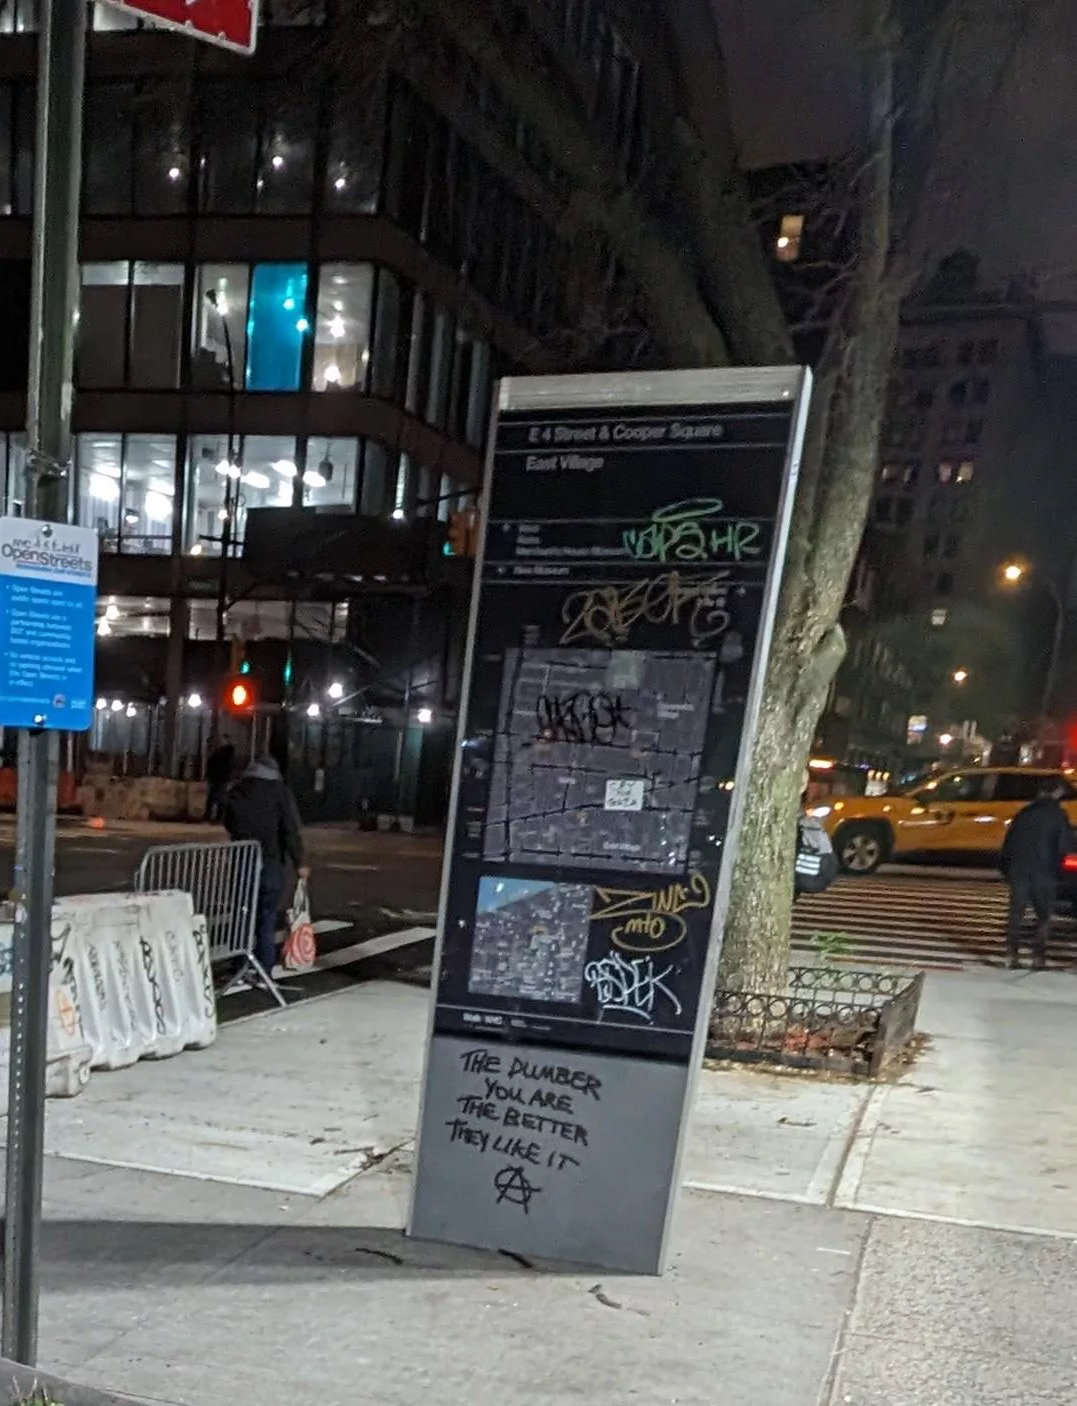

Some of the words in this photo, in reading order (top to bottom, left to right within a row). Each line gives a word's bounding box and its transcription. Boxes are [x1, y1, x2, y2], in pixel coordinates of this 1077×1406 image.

[528, 427, 540, 442] E
[541, 427, 552, 441] 4
[554, 426, 597, 442] Street
[598, 424, 610, 440] &
[612, 424, 667, 441] Cooper
[669, 422, 723, 439] Square
[526, 455, 558, 472] East
[559, 454, 605, 472] Village
[459, 1048, 502, 1075] THE
[508, 1056, 602, 1101] DUMBER
[483, 1077, 527, 1106] YOU
[528, 1088, 575, 1115] ARE
[456, 1094, 501, 1121] THE
[502, 1107, 589, 1147] BETTER
[445, 1118, 490, 1153] THEY
[492, 1135, 541, 1166] LIKE
[547, 1152, 581, 1171] IT
